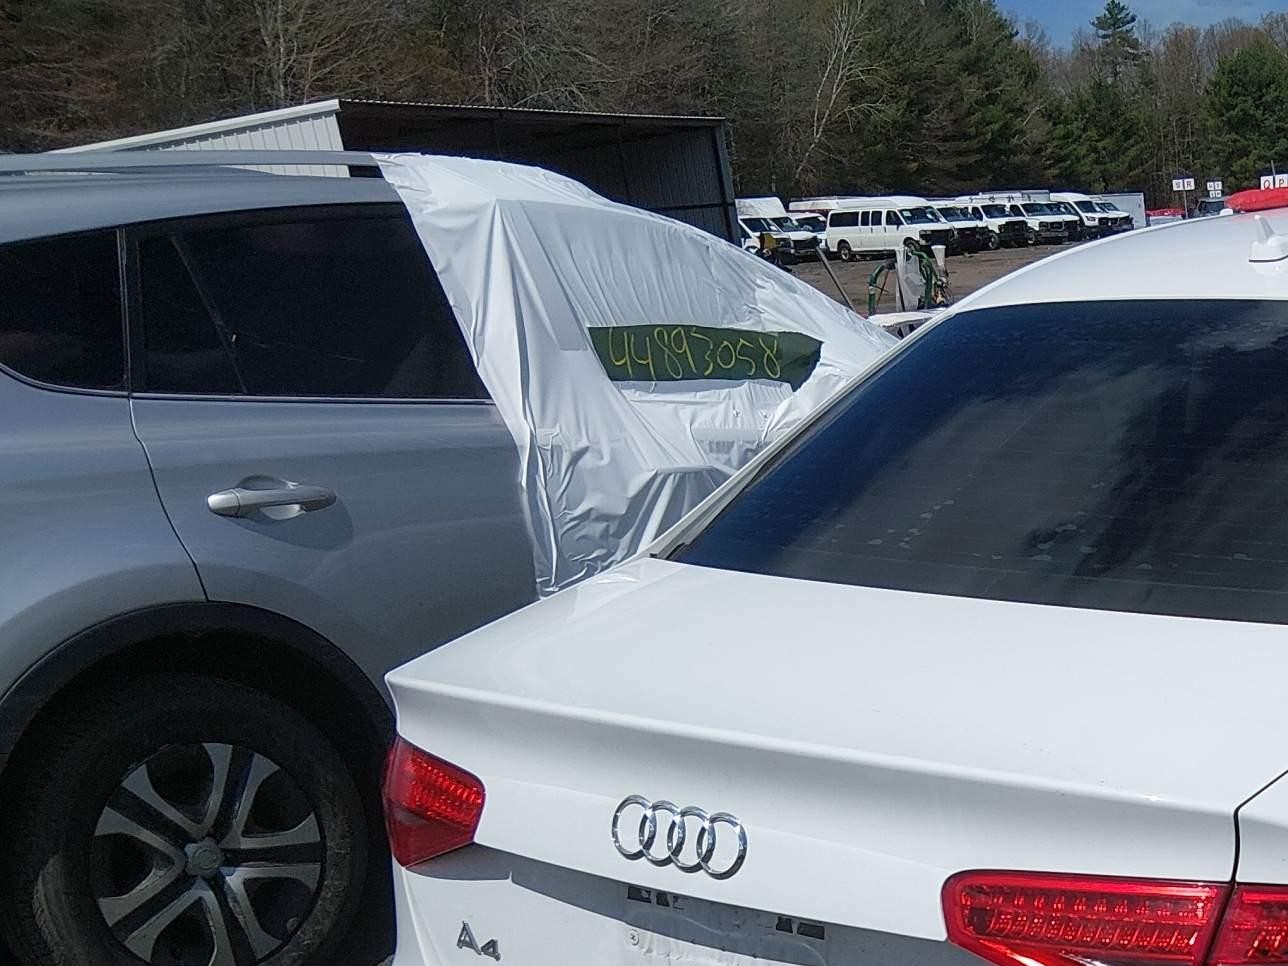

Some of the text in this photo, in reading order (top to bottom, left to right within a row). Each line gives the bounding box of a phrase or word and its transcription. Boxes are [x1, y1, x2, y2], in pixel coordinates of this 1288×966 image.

[1278, 178, 1285, 188] P
[608, 325, 781, 381] 44893058
[456, 920, 501, 961] A4
